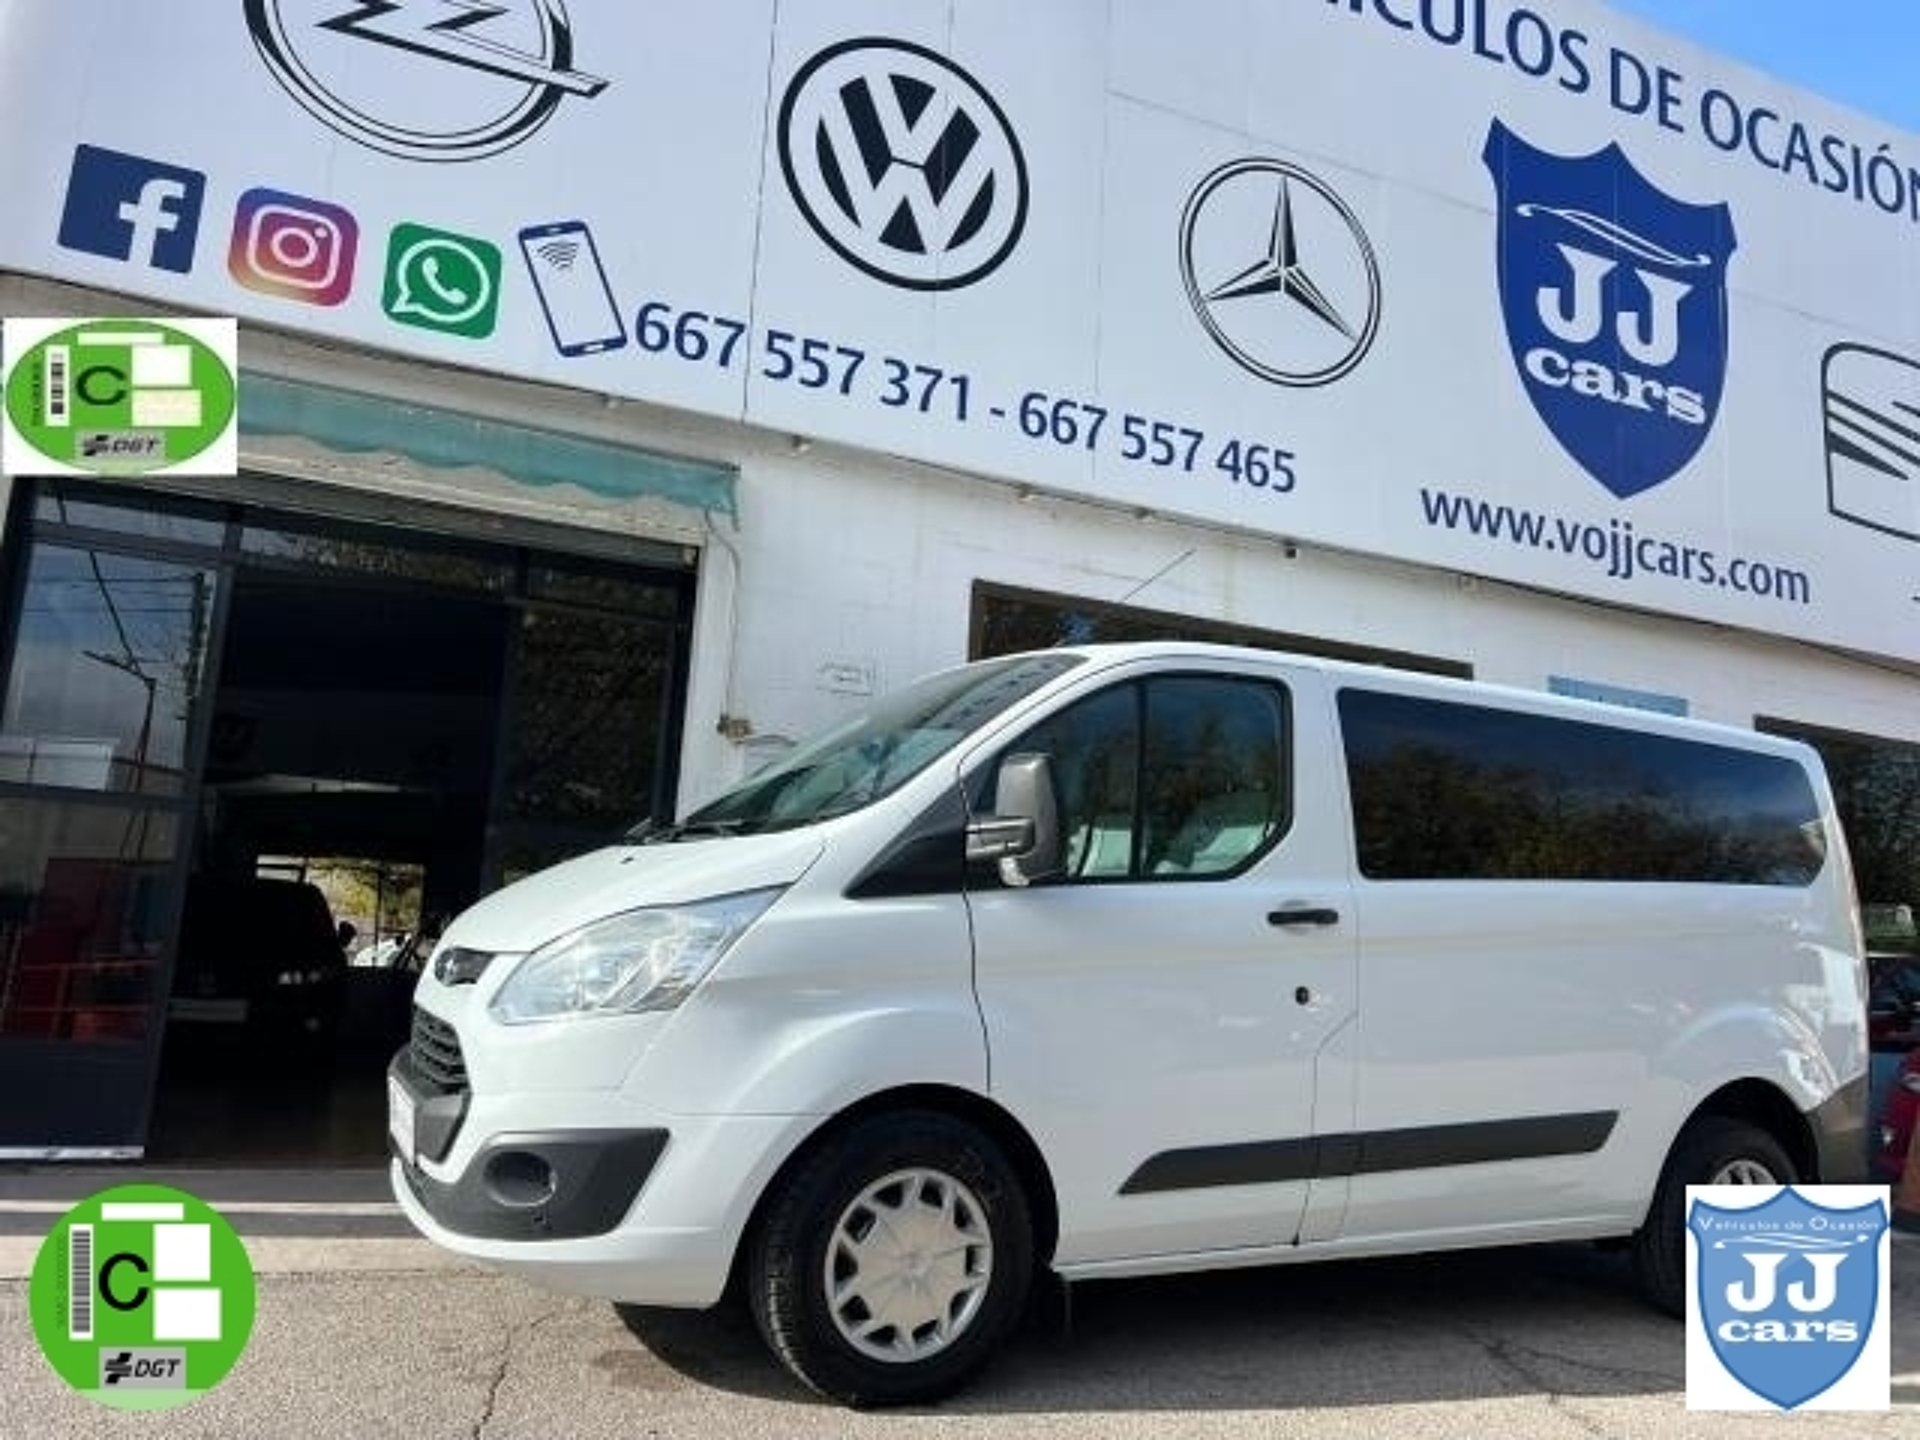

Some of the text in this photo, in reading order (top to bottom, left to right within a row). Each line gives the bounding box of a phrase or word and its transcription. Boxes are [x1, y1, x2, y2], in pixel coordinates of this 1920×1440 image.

[1610, 47, 1685, 133] DE
[1535, 242, 1695, 366] JJ
[635, 302, 746, 367] 667
[763, 329, 865, 395] 557
[880, 358, 969, 421] 371
[1019, 392, 1108, 450] 667
[1121, 414, 1204, 472] 557
[1216, 440, 1295, 492] 465
[1524, 348, 1706, 425] cars
[1420, 488, 1810, 604] www.vojjcars.com
